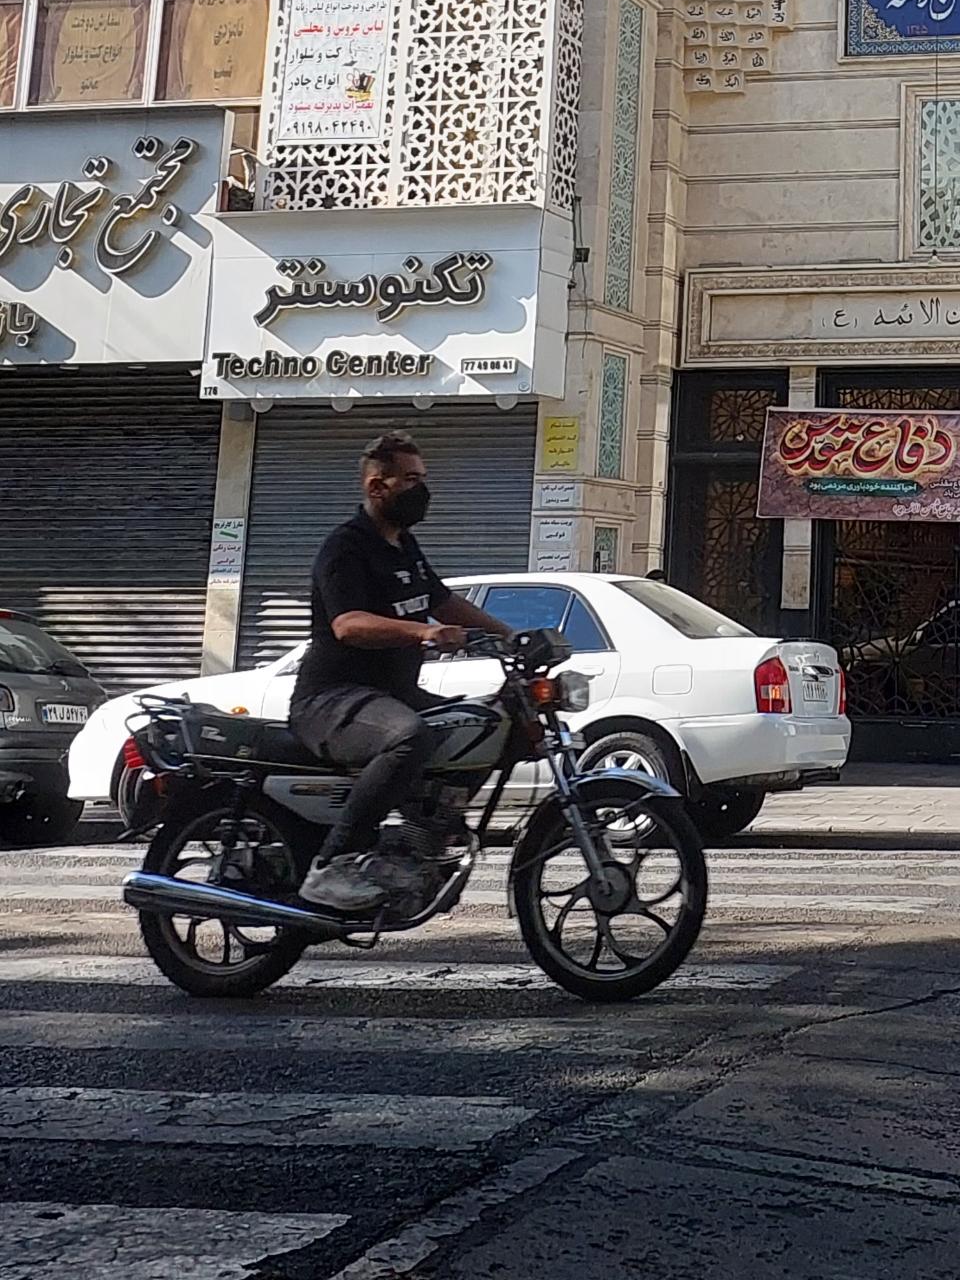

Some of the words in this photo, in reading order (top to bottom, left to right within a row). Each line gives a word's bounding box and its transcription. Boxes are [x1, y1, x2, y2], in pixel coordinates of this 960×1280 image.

[293, 21, 325, 38] مجلسی
[333, 22, 361, 37] عروس
[362, 20, 384, 36] لباس
[288, 47, 314, 65] شلوار
[325, 46, 343, 59] کت
[287, 73, 312, 91] چادر
[314, 72, 340, 90] انواع
[94, 135, 196, 273] مجتمع
[252, 255, 378, 328] سنتر
[375, 251, 494, 325] تکنو
[212, 349, 320, 379] Techno
[326, 348, 434, 378] Center
[779, 414, 868, 471] مقدس
[852, 416, 954, 474] دفاع
